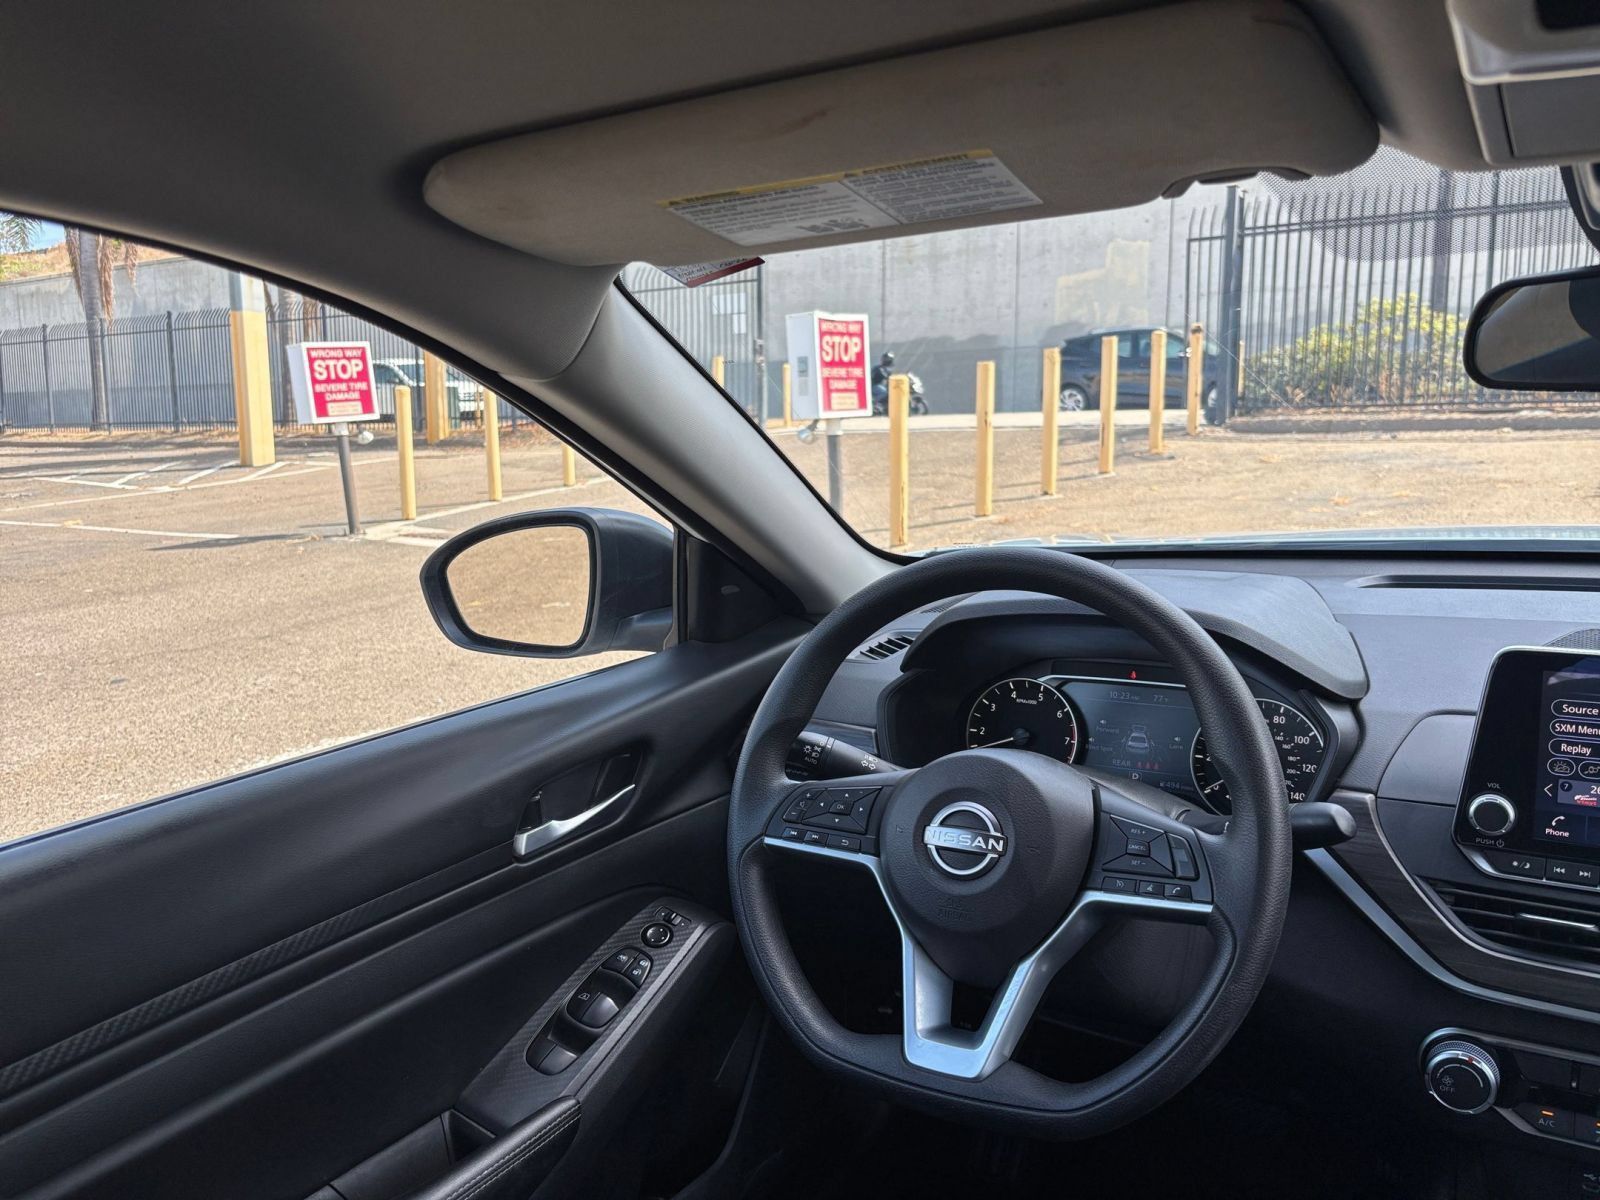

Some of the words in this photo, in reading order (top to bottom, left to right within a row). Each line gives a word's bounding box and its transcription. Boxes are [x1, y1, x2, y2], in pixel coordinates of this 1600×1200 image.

[821, 335, 861, 362] STOP
[309, 349, 343, 359] WRONG
[343, 349, 363, 358] WAY
[313, 359, 363, 380] STOP
[314, 383, 347, 393] SEVERE
[348, 382, 368, 391] TIRE
[325, 392, 360, 401] DAMAGE
[1010, 691, 1017, 699] 4
[1038, 693, 1044, 701] 5
[990, 703, 996, 712] 3
[1562, 704, 1599, 716] Source
[1056, 710, 1063, 718] 6
[1273, 715, 1286, 724] 80
[979, 727, 986, 735] 2
[1555, 722, 1576, 733] SXM
[1064, 736, 1070, 745] 7
[1294, 735, 1310, 745] 100
[1560, 743, 1592, 757] Replay
[1112, 760, 1131, 768] REAR
[1302, 763, 1318, 773] 120
[1290, 792, 1306, 802] 140
[1545, 828, 1570, 838] Phone
[925, 829, 1004, 852] NISSAN
[1475, 837, 1495, 845] PUSH
[1538, 1118, 1556, 1127] A/C
